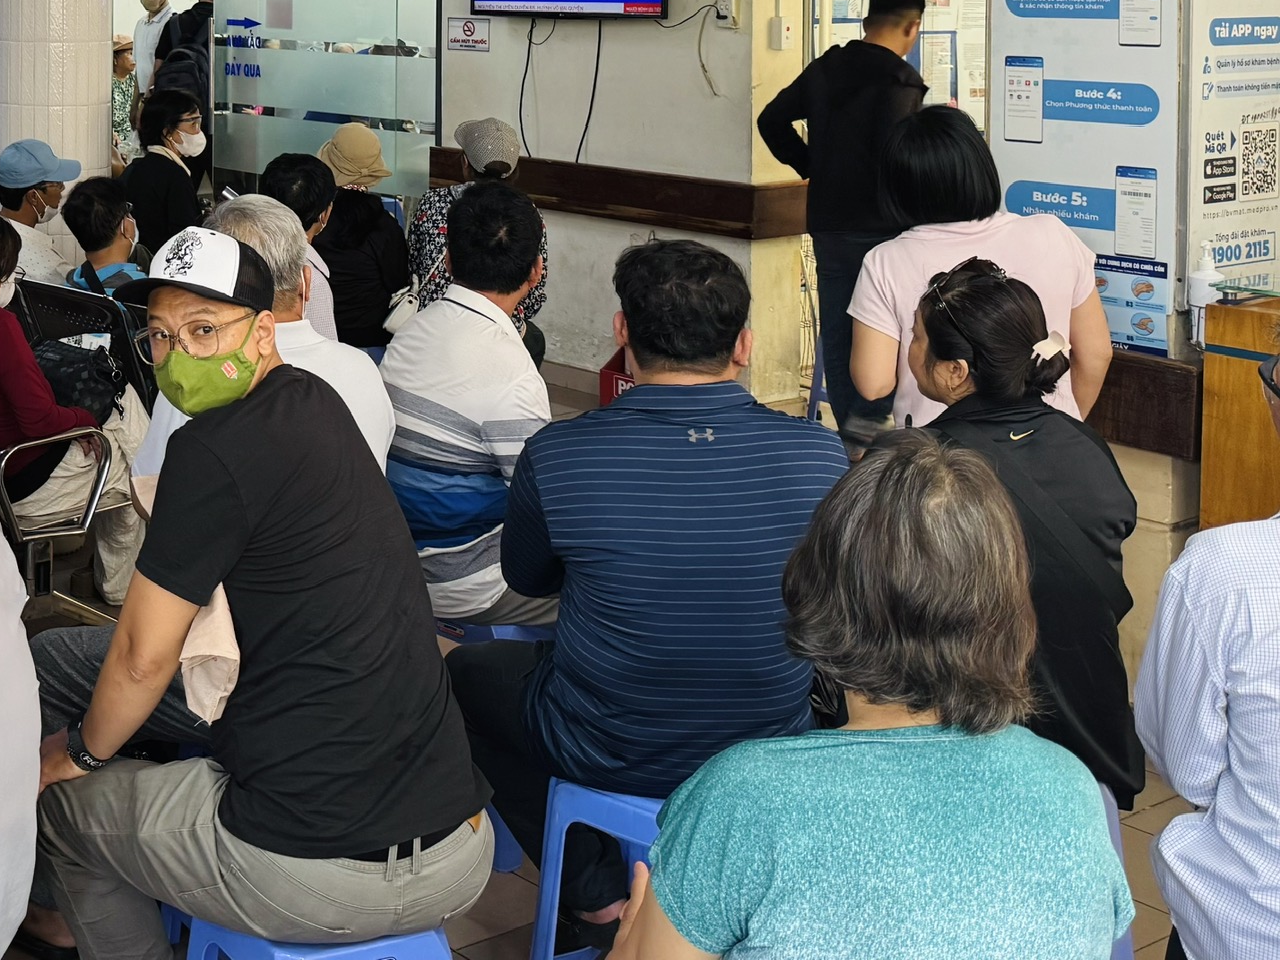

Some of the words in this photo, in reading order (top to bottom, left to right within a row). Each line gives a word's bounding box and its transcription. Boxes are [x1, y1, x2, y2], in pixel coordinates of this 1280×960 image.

[1036, 2, 1054, 10] nhận
[1054, 2, 1074, 11] thông
[1214, 22, 1230, 38] Tải
[1231, 23, 1252, 37] APP
[1253, 25, 1279, 40] ngay
[243, 63, 261, 78] QUA
[1074, 88, 1104, 99] Bước
[1106, 87, 1122, 100] 4:
[1045, 100, 1065, 108] Chọn
[1065, 100, 1093, 110] Phương
[1093, 101, 1111, 110] thức
[1112, 103, 1135, 112] thanh
[1135, 104, 1153, 113] toán
[1204, 130, 1225, 142] Quét
[1204, 143, 1216, 154] Mã
[1216, 142, 1227, 155] QR
[1213, 166, 1223, 176] App
[1222, 165, 1235, 174] Store
[1032, 190, 1068, 205] Bước
[1070, 191, 1088, 208] 5:
[1212, 191, 1227, 201] Google
[1073, 210, 1100, 222] khám
[1215, 230, 1230, 244] Tổng
[1250, 227, 1267, 238] khám
[1211, 243, 1242, 264] 1900
[1245, 239, 1270, 259] 2115
